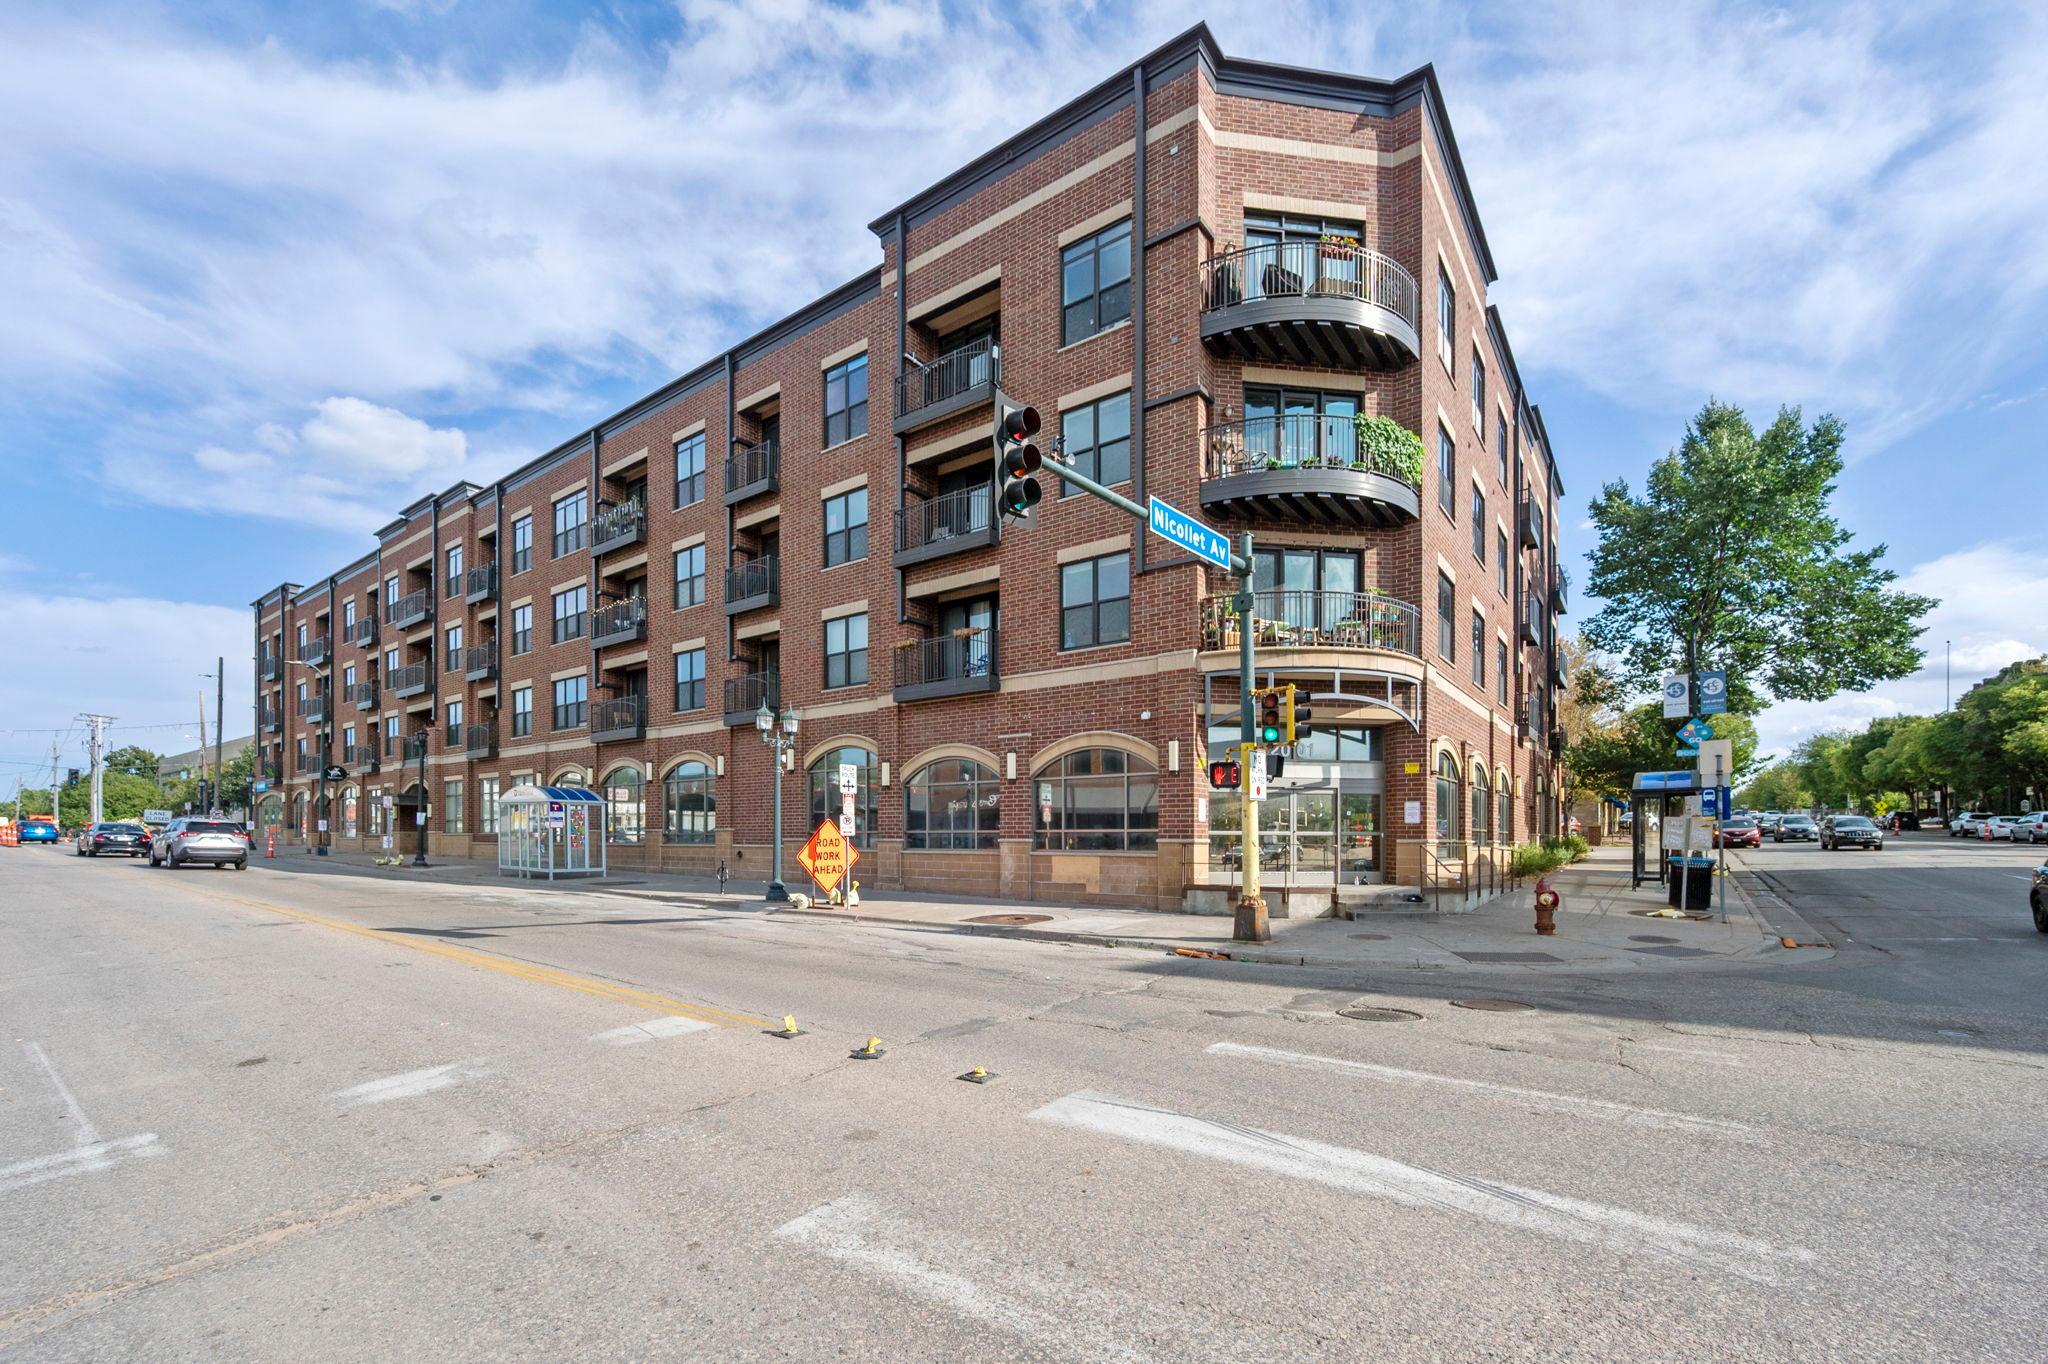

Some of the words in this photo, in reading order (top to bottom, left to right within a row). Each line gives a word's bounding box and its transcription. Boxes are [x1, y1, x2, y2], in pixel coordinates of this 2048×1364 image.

[1154, 506, 1206, 551] Nicollet
[1210, 538, 1227, 561] Av
[816, 838, 840, 848] ROAD
[816, 851, 840, 861] WORK
[814, 864, 843, 874] AHEAD
